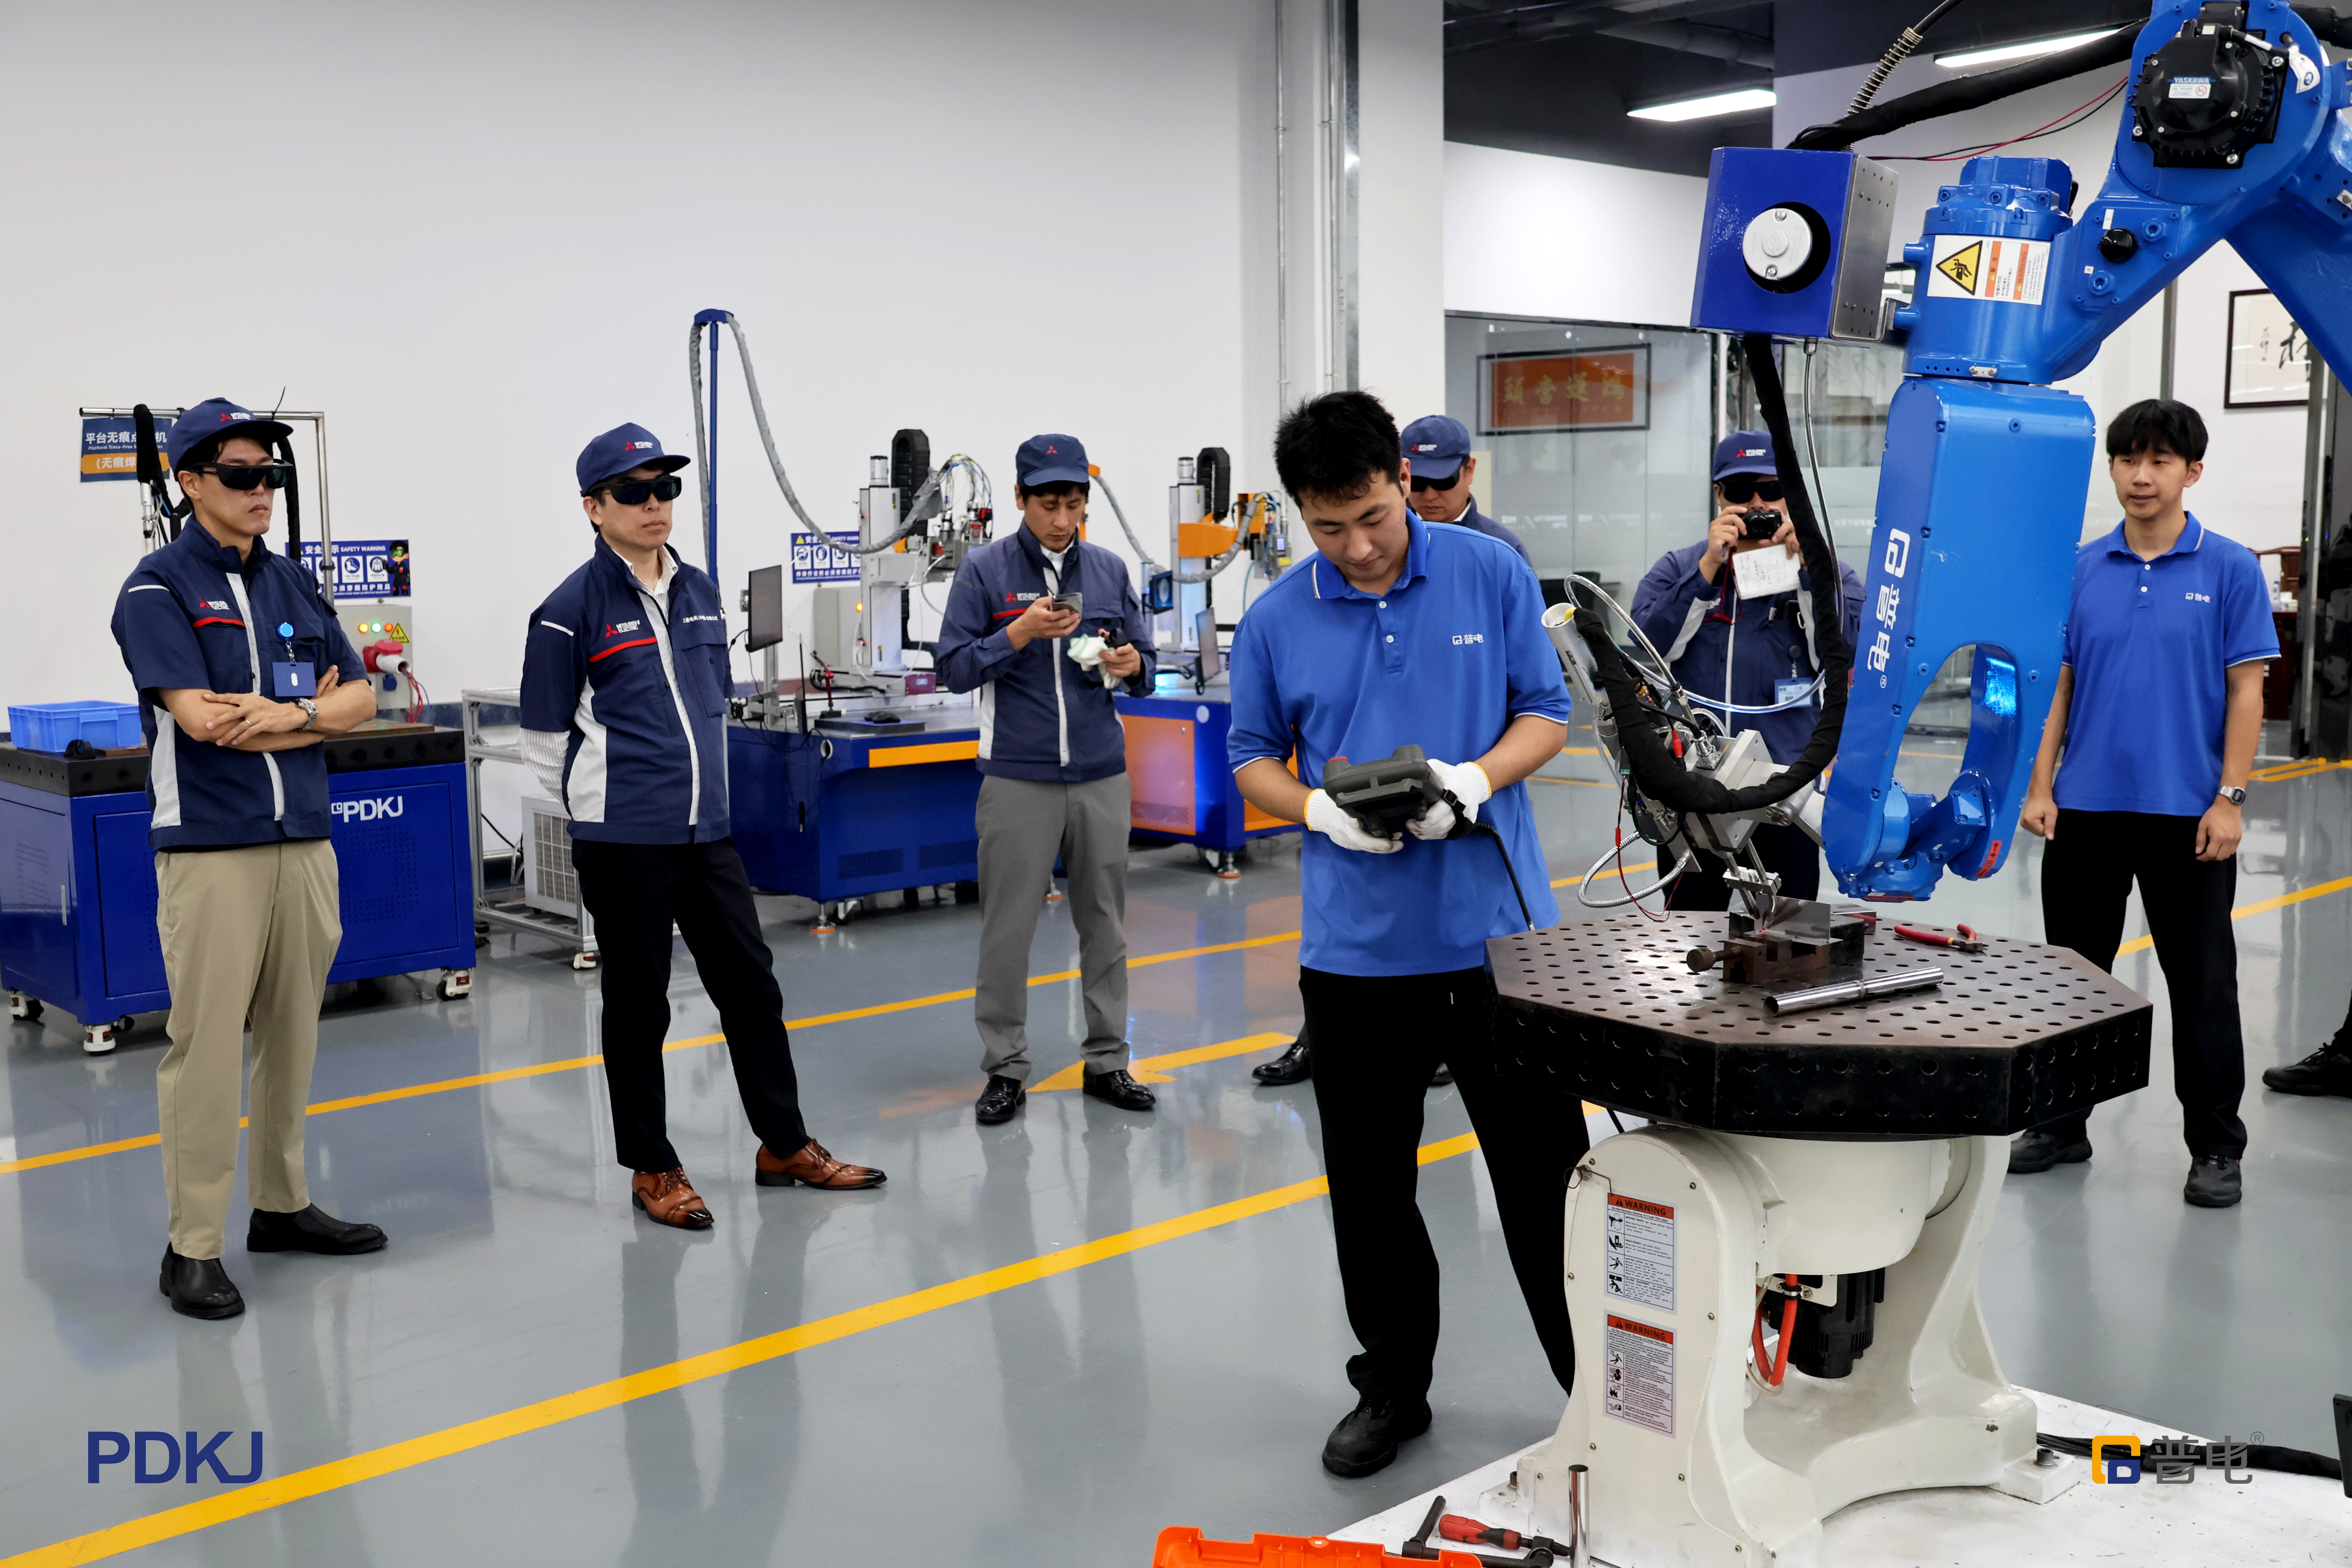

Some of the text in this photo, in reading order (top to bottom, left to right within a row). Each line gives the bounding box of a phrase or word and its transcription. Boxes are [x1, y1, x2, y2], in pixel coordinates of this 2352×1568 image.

[2017, 251, 2027, 283] WARNING
[85, 431, 167, 444] 平台无痕点机
[305, 545, 339, 554] 安全示
[615, 620, 640, 629] MITSUBISHI
[1867, 583, 1900, 672] 普电
[1463, 633, 1484, 644] 普电
[343, 795, 403, 823] PDKJ
[1625, 1200, 1666, 1216] WARNING
[1625, 1322, 1666, 1340] WARNING
